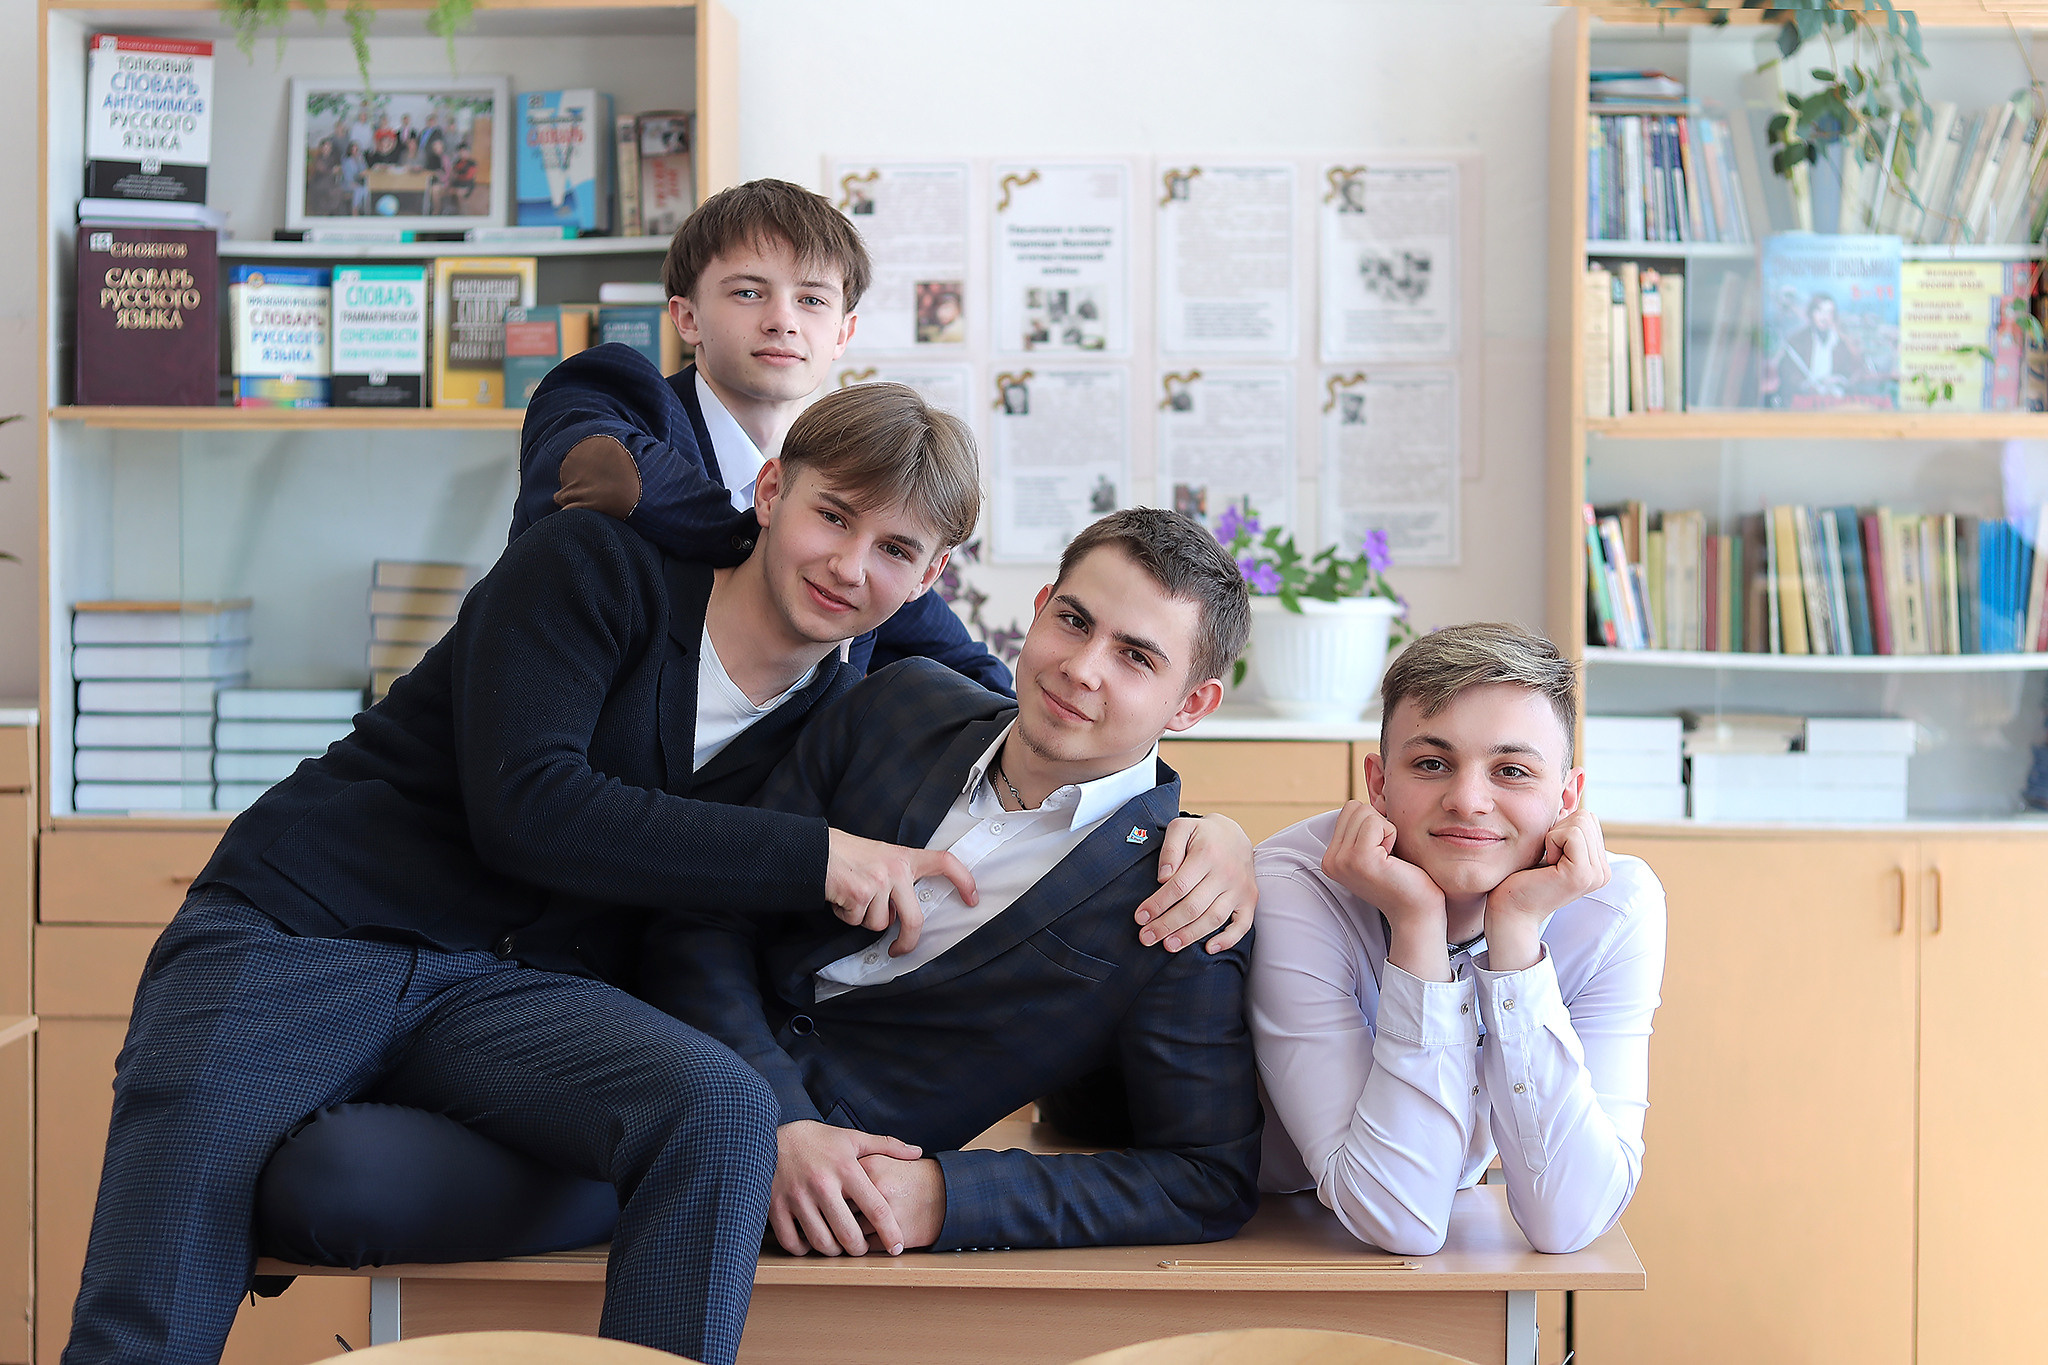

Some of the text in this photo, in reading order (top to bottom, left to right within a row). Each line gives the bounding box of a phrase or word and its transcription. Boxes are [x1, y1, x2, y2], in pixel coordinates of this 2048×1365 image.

[118, 56, 194, 74] ТОЛКОВЫЙ
[110, 72, 200, 95] СЛОВАРЬ
[102, 93, 205, 113] АНТОНИМОВ
[110, 112, 197, 132] РУССКОГО
[122, 131, 181, 150] ЯЗЫКА
[105, 267, 194, 289] СЛОВАРЬ
[100, 288, 201, 311] РУССКОГО
[346, 285, 415, 307] СЛОВАРЬ
[115, 308, 184, 329] ЯЗЫКА
[249, 308, 326, 326] СЛОВАРЬ
[251, 329, 326, 345] РУССКОГО
[262, 347, 315, 362] ЯЗЫКА
